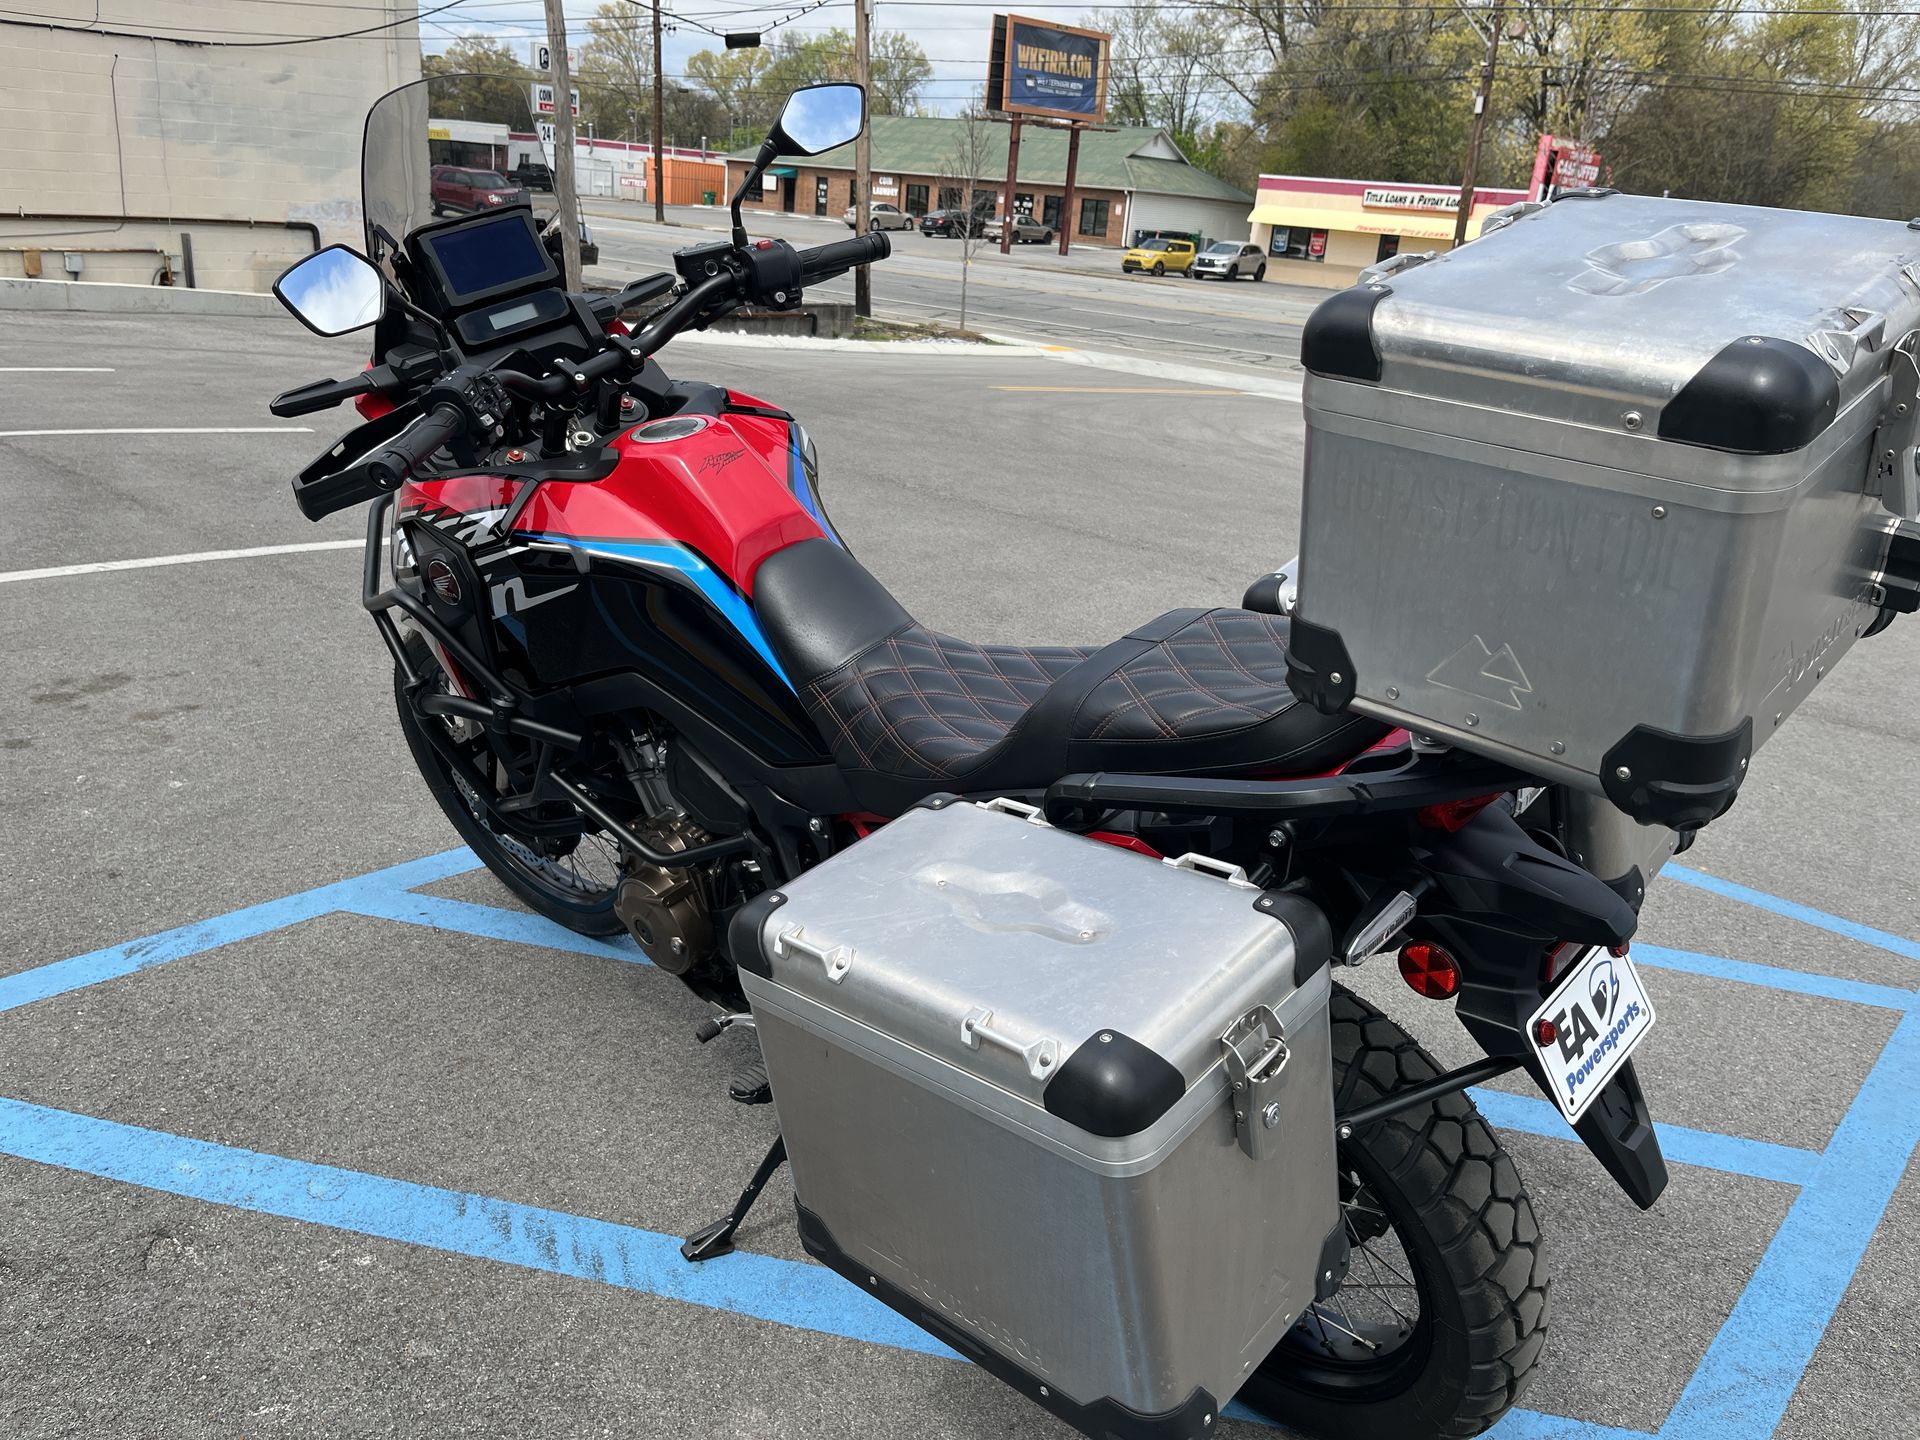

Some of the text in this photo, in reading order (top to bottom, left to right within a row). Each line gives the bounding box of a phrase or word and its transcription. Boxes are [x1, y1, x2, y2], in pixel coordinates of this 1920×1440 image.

[1017, 43, 1092, 78] WKFIRM.COM
[539, 88, 553, 102] COIN
[542, 126, 551, 141] 24
[1551, 1001, 1600, 1065] EA
[1565, 1001, 1641, 1095] Powersports
